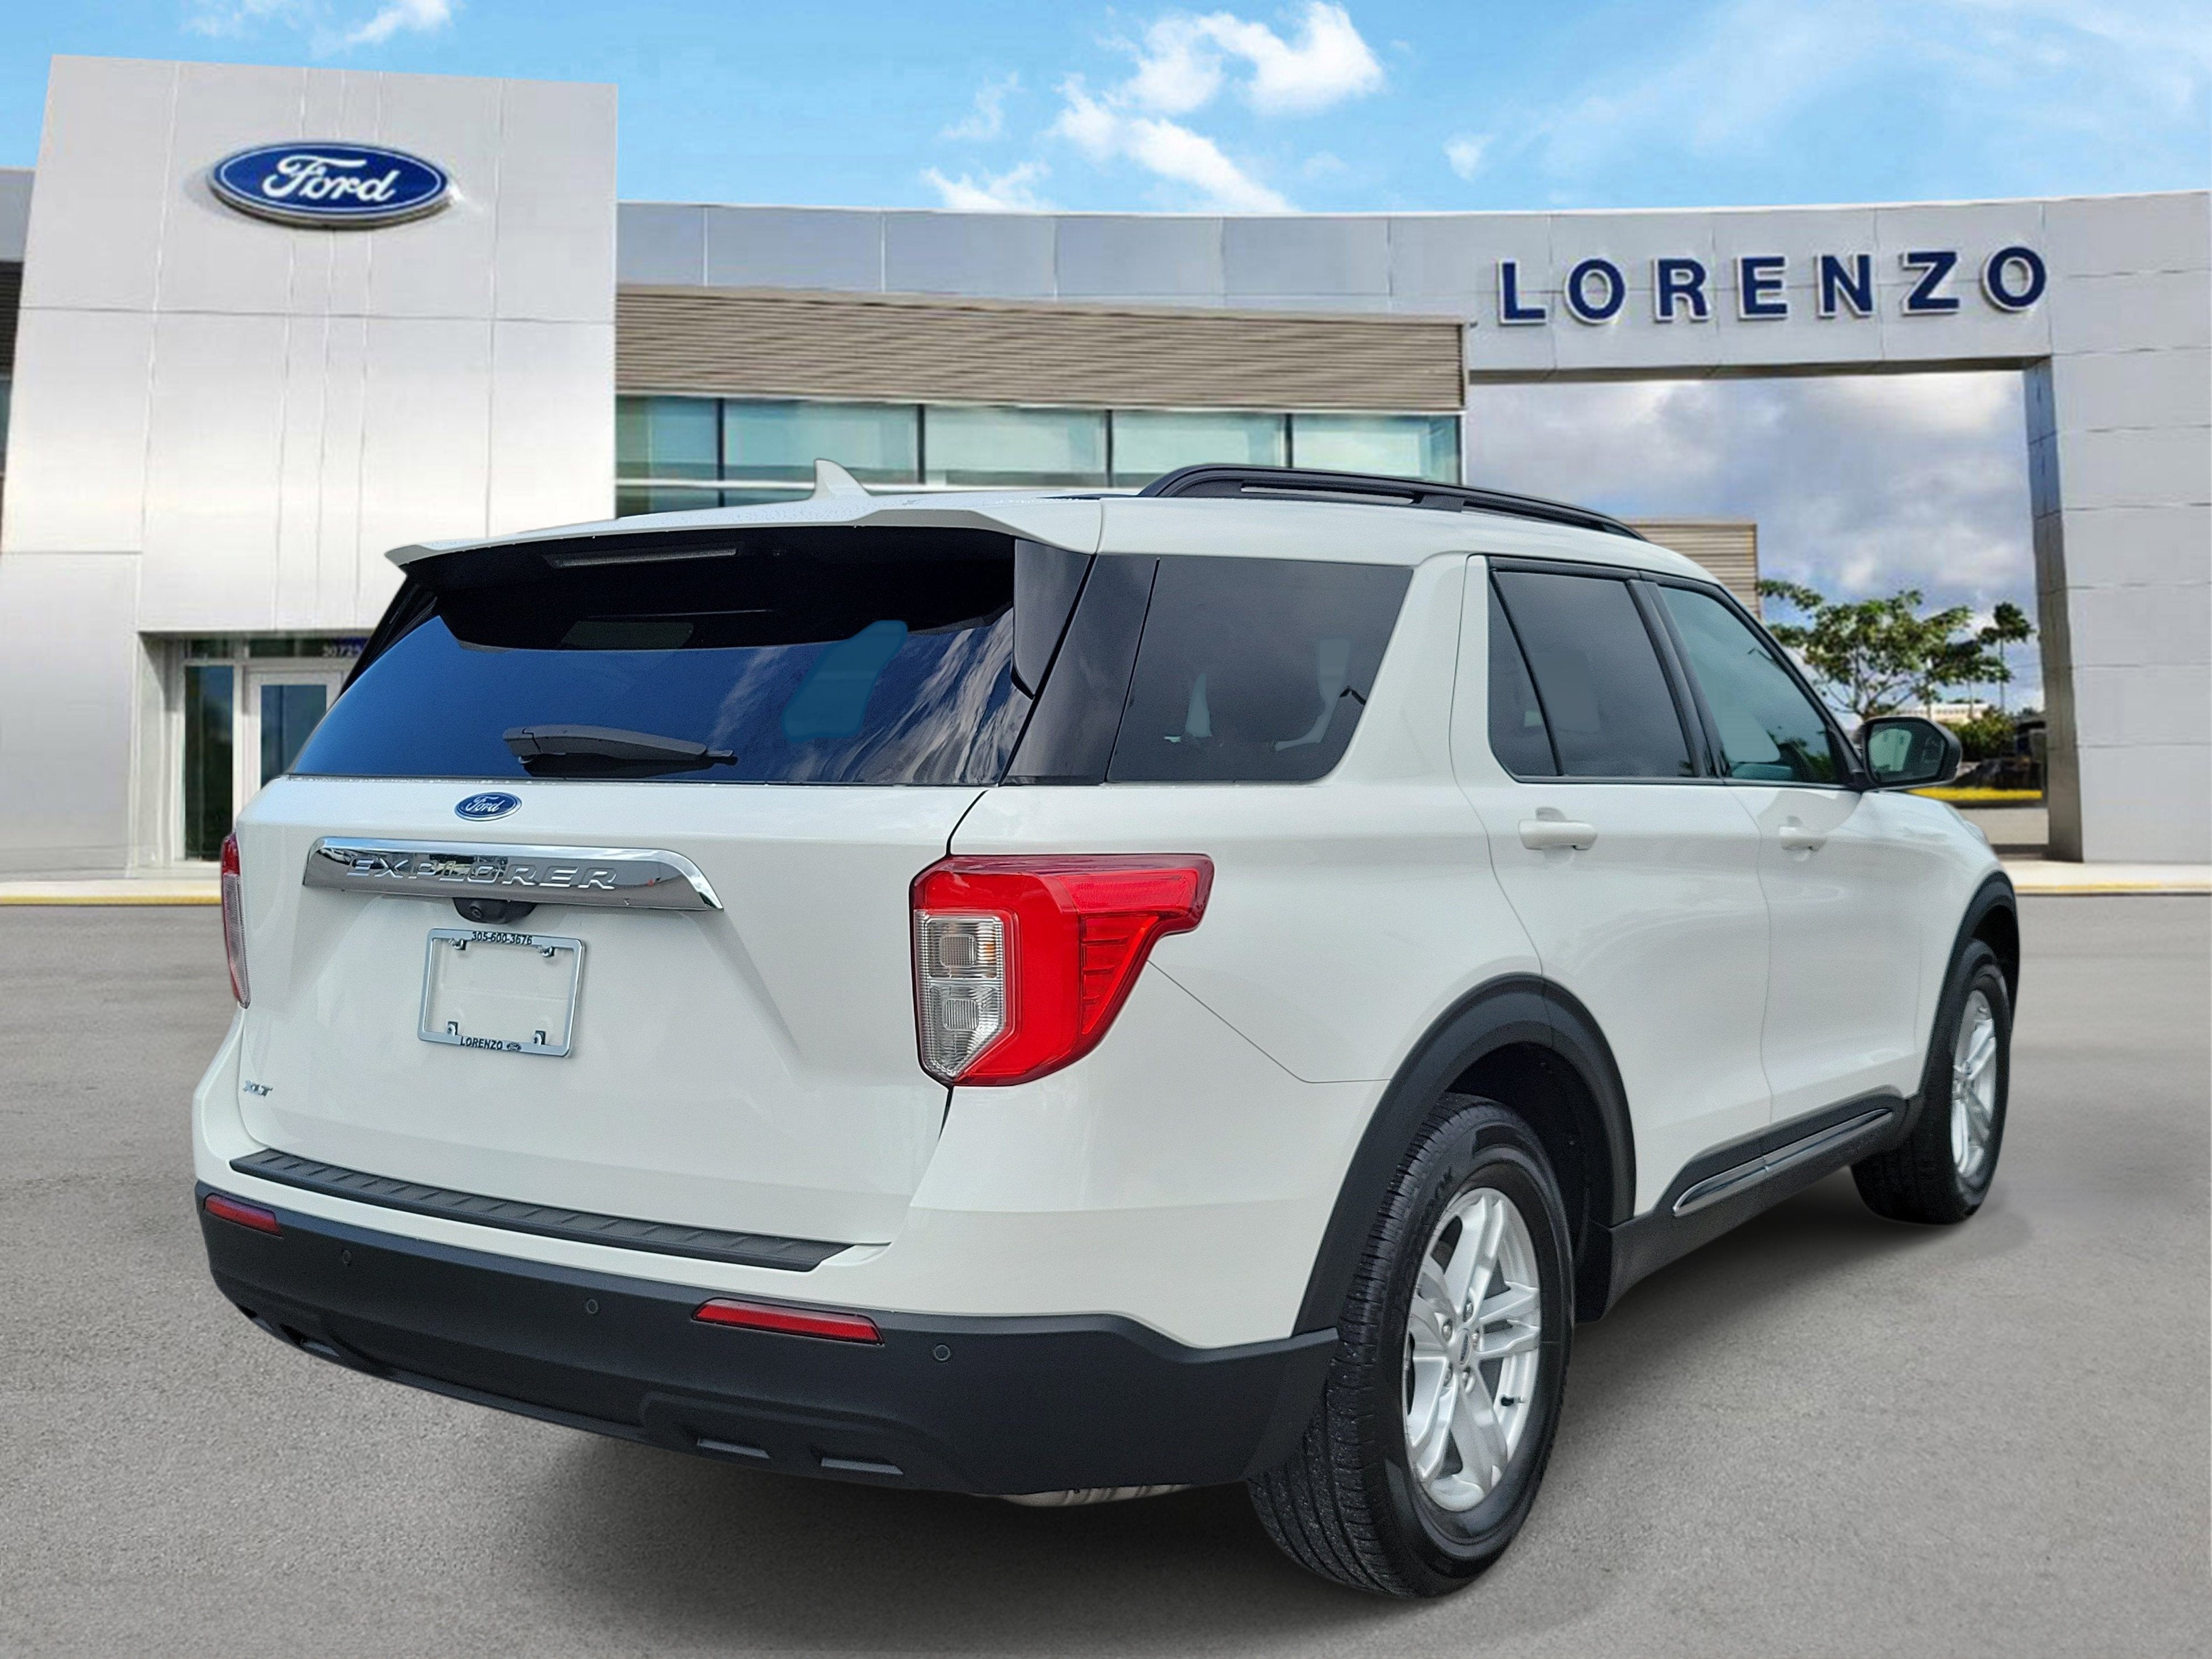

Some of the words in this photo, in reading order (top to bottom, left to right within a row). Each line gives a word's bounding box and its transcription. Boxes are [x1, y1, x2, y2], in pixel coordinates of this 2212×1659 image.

[262, 154, 400, 201] Ford
[1497, 246, 2046, 325] LORENZO
[465, 796, 505, 812] Ford
[346, 858, 617, 890] EXPLORER
[472, 931, 532, 944] 305-600-3676
[460, 1036, 503, 1050] LORENZO
[242, 1081, 273, 1097] XLT
